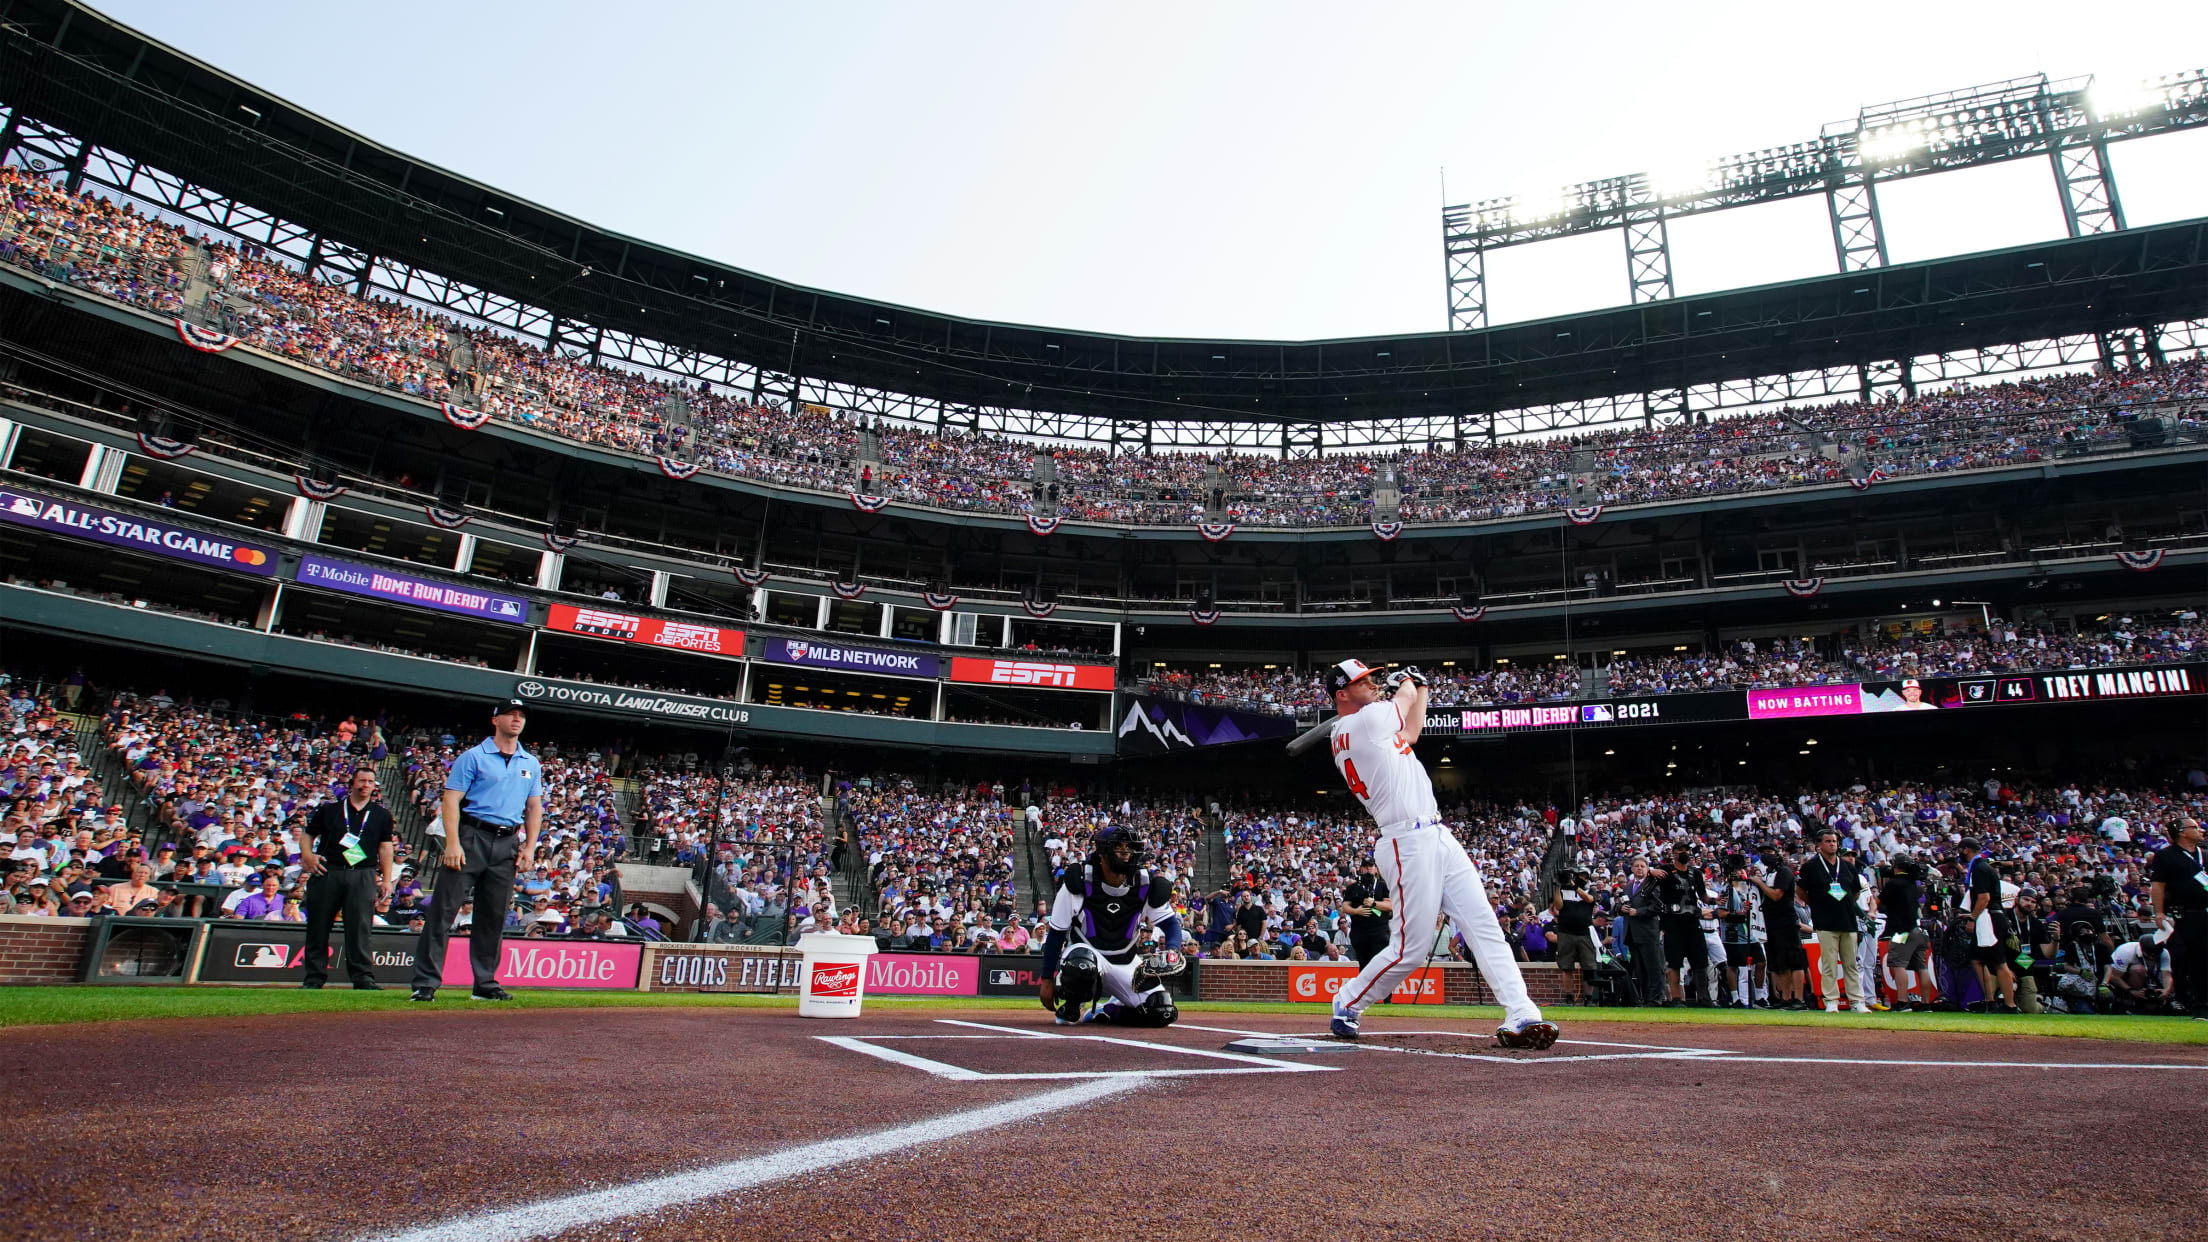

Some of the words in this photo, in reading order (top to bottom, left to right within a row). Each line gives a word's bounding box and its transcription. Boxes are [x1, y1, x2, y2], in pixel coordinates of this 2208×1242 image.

[163, 531, 234, 560] GAME
[321, 566, 369, 587] Mobile
[371, 574, 411, 596] HOME
[413, 583, 443, 601] RUN
[443, 589, 489, 610] DERBY
[574, 624, 634, 638] RADIO
[575, 609, 640, 631] ESPN
[662, 621, 720, 641] ESPN
[653, 633, 721, 652] DEPORTES
[808, 646, 841, 661] MLB
[842, 650, 919, 670] NETWORK
[991, 660, 1076, 686] ESPN
[2043, 675, 2090, 698] TREY
[2096, 669, 2190, 696] MANCINI
[1758, 698, 1788, 710] NOW
[1793, 695, 1853, 708] BATTING
[2007, 683, 2024, 697] 44
[547, 686, 612, 706] TOYOTA
[710, 707, 749, 723] CLUB
[1462, 711, 1500, 729] HOME
[1501, 709, 1532, 727] RUN
[1532, 706, 1579, 726] DERBY
[1617, 702, 1660, 719] 2021
[503, 947, 615, 981] Mobile
[660, 956, 729, 986] COORS
[868, 960, 960, 989] Mobile
[814, 970, 857, 985] Rawlings
